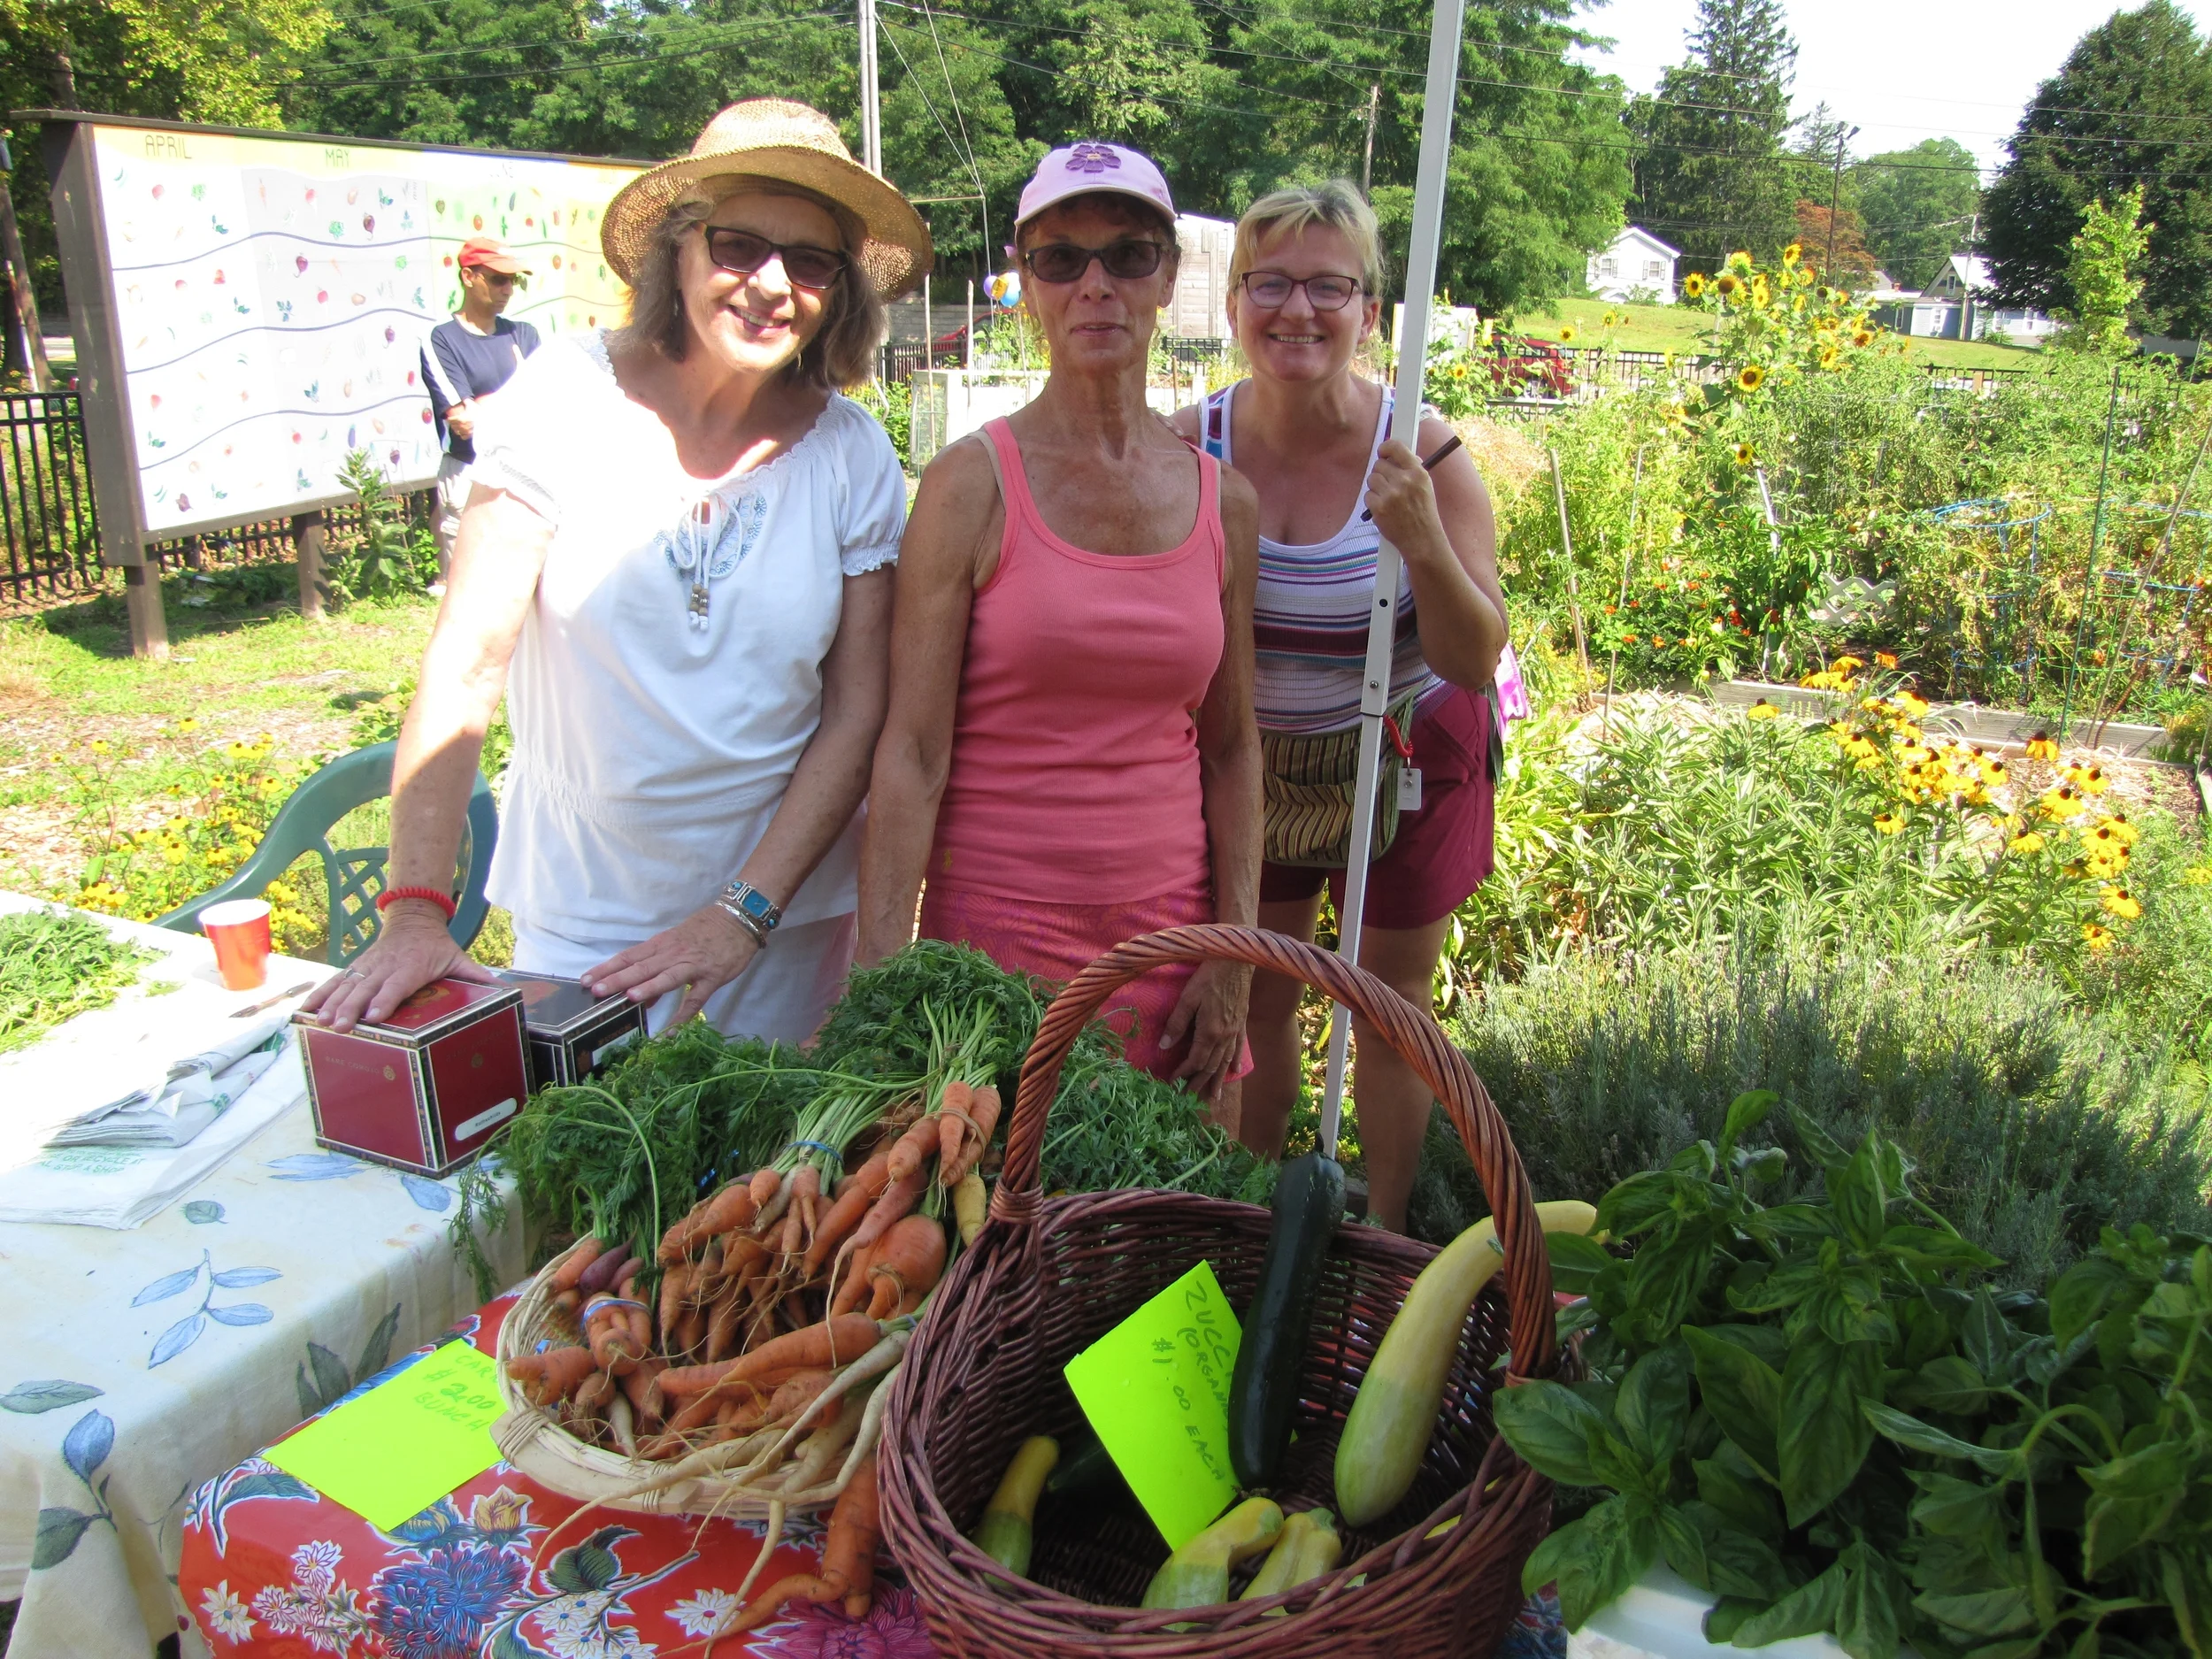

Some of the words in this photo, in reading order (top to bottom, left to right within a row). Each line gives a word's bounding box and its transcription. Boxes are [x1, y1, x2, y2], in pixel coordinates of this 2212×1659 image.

[145, 134, 192, 159] APRIL
[325, 148, 349, 167] MAY
[1186, 1280, 1232, 1377] ZUCC
[414, 1392, 489, 1431] BUNCH
